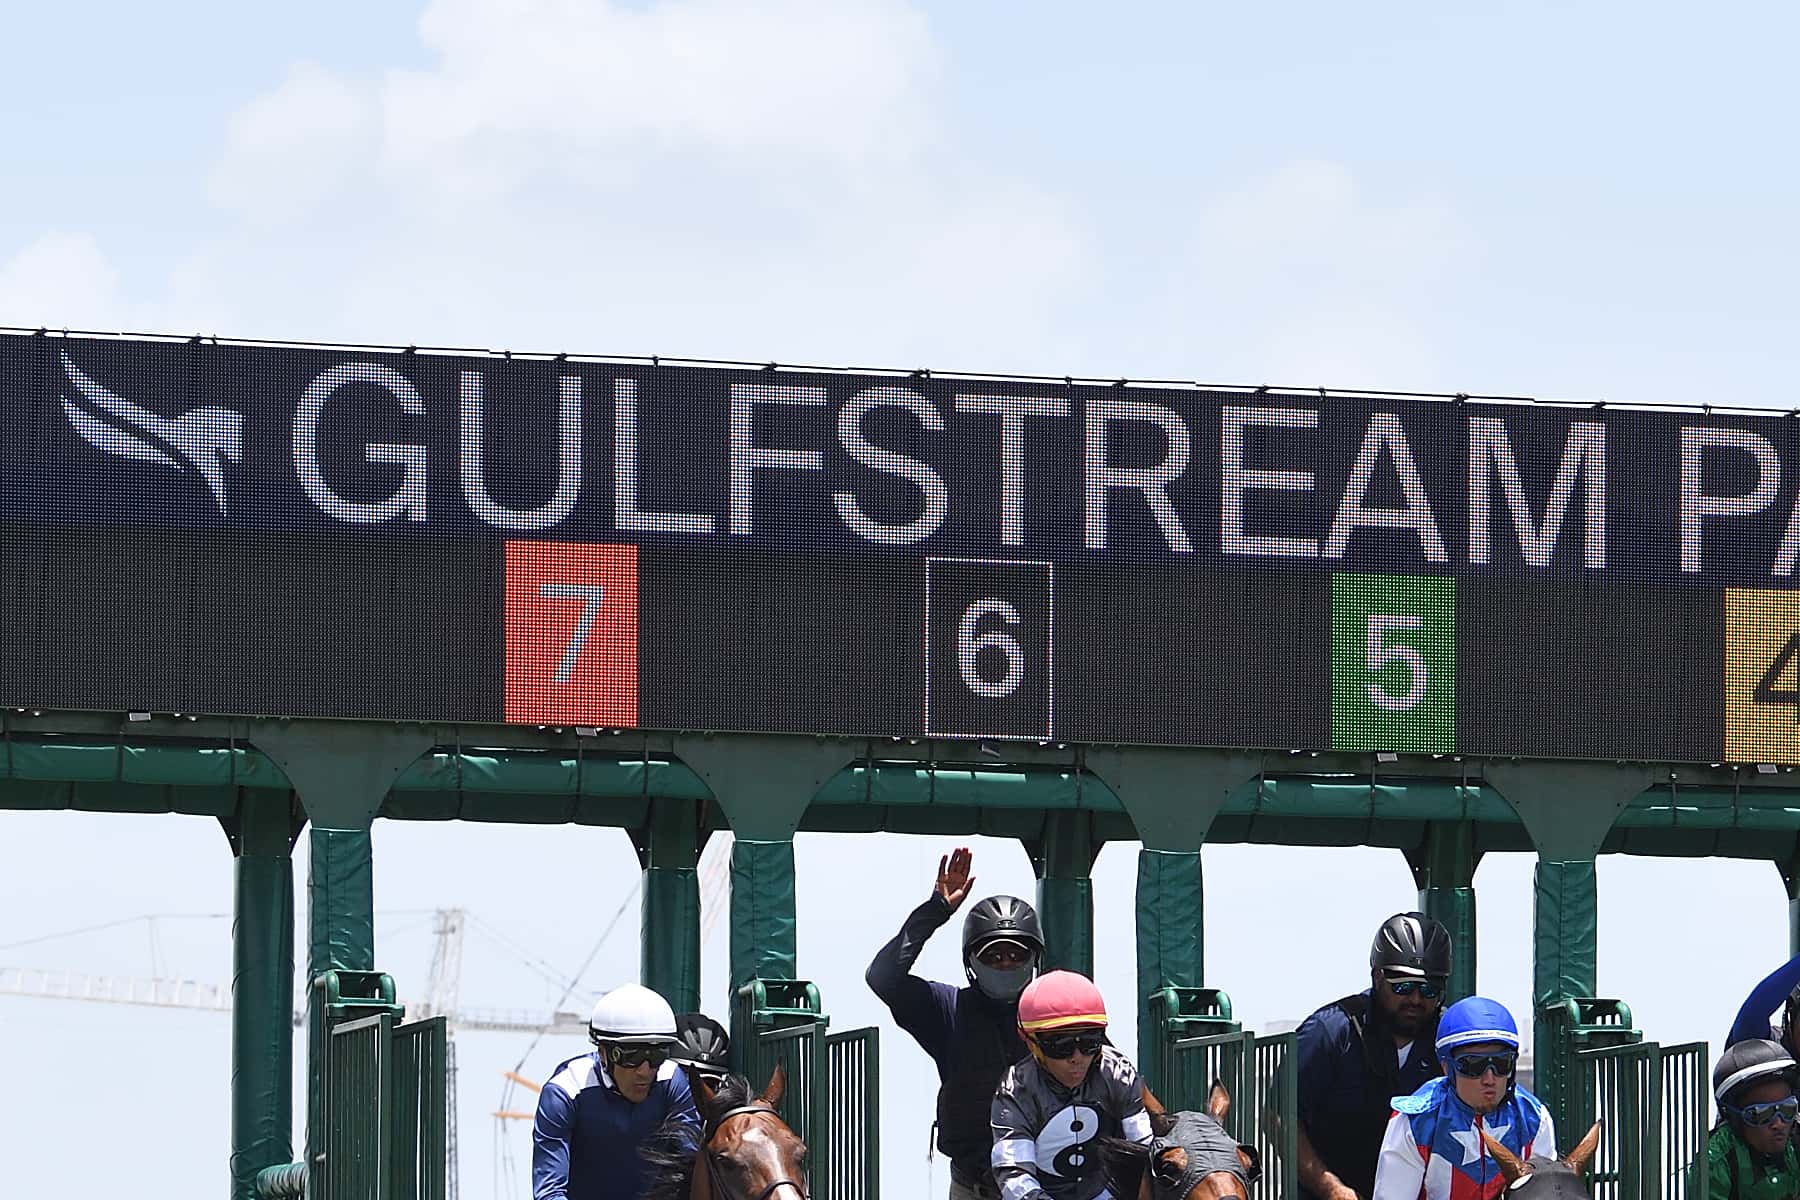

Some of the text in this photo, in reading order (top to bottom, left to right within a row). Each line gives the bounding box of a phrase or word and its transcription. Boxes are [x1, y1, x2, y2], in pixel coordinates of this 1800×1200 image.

[293, 362, 1606, 568] GULFSTREAM
[538, 583, 604, 684] 7
[957, 598, 1024, 698] 6
[1366, 614, 1428, 711] 5
